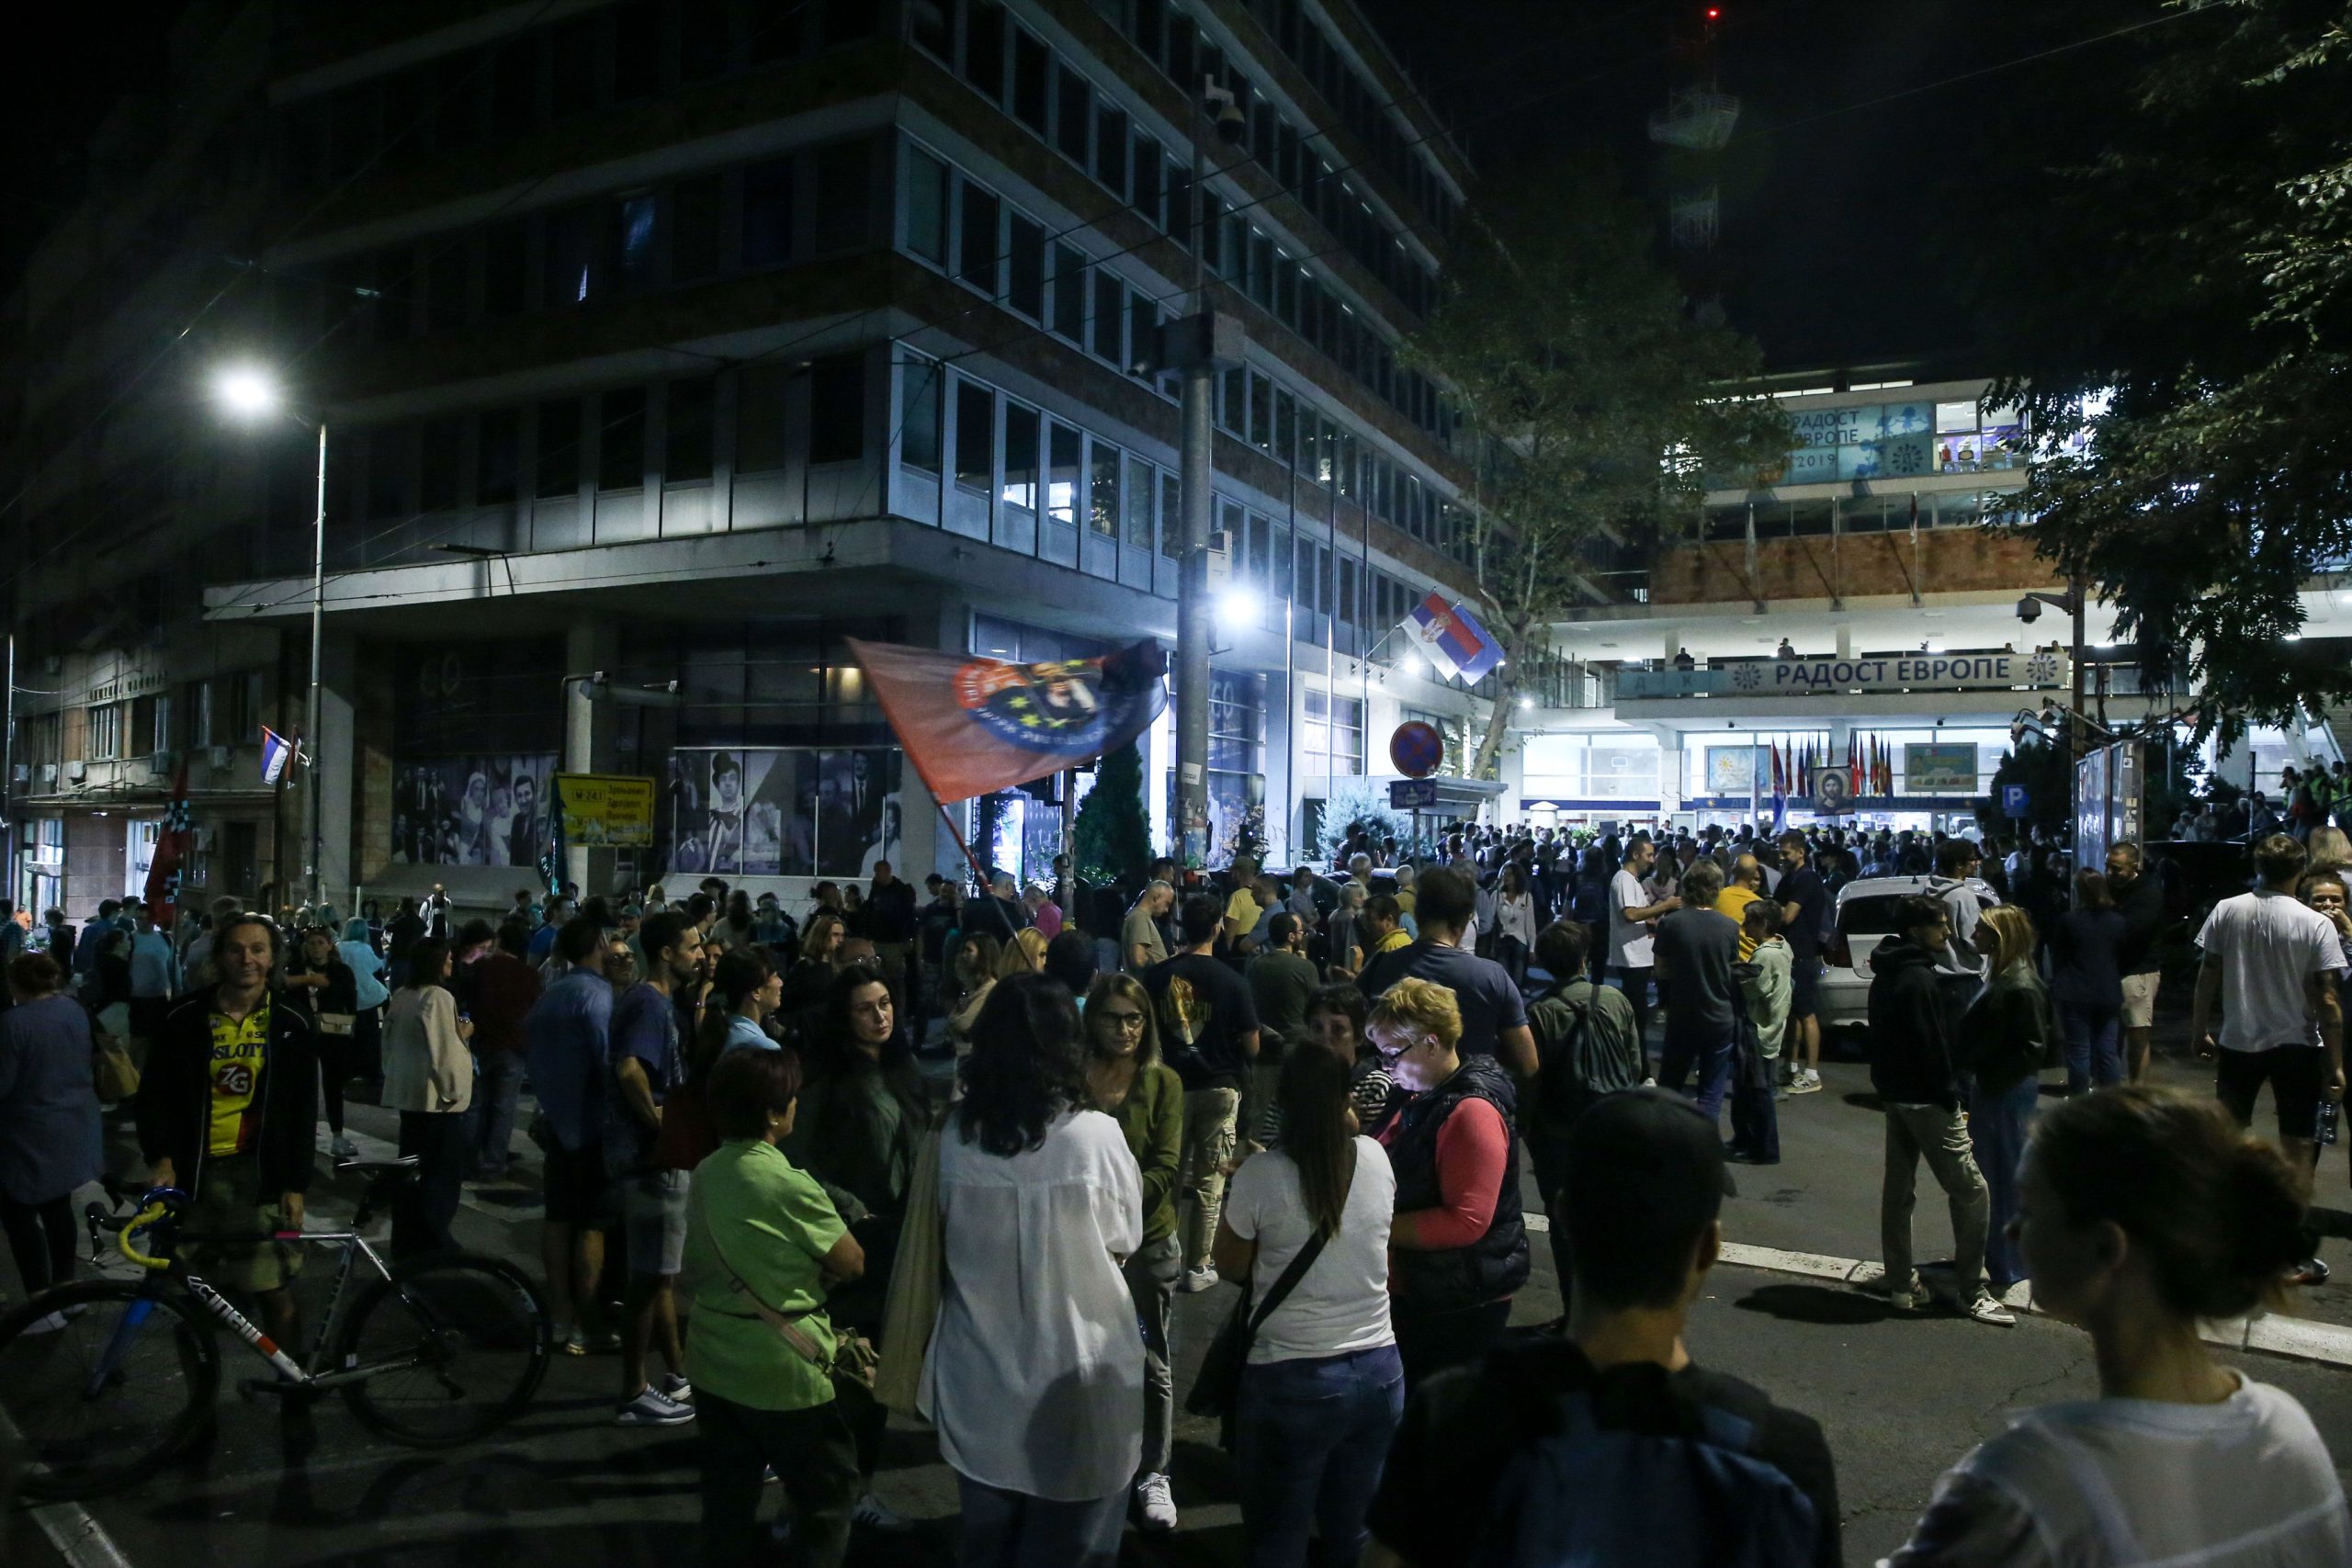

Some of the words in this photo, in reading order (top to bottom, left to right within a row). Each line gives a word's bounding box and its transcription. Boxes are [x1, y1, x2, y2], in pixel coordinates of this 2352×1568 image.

[1797, 454, 1836, 468] 2019
[1775, 660, 1888, 688] РАДОСТ
[1897, 658, 2010, 682] ЕВРОПЕ
[2008, 787, 2022, 806] P
